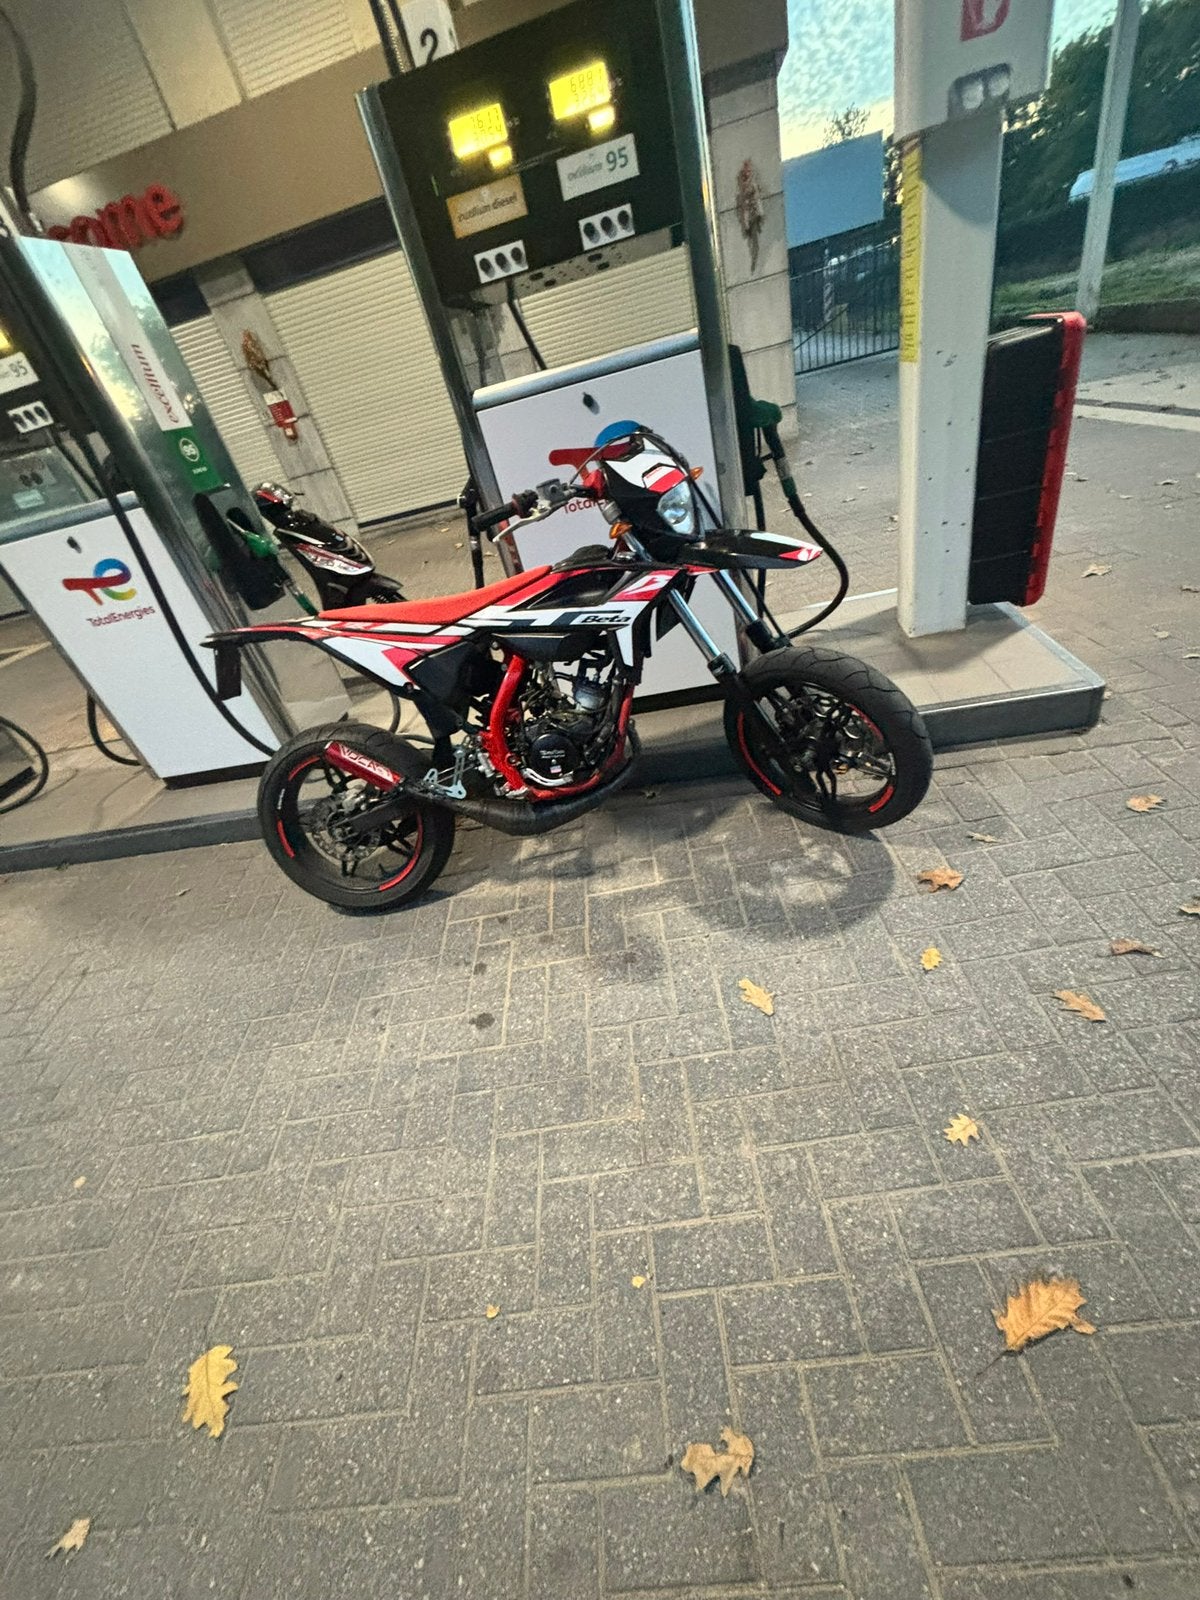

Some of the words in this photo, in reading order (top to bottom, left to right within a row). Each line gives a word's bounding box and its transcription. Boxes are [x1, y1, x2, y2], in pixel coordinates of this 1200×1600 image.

[605, 145, 629, 172] 95
[8, 360, 29, 378] 95
[86, 605, 156, 627] TotalEnergies
[581, 611, 632, 624] Beta
